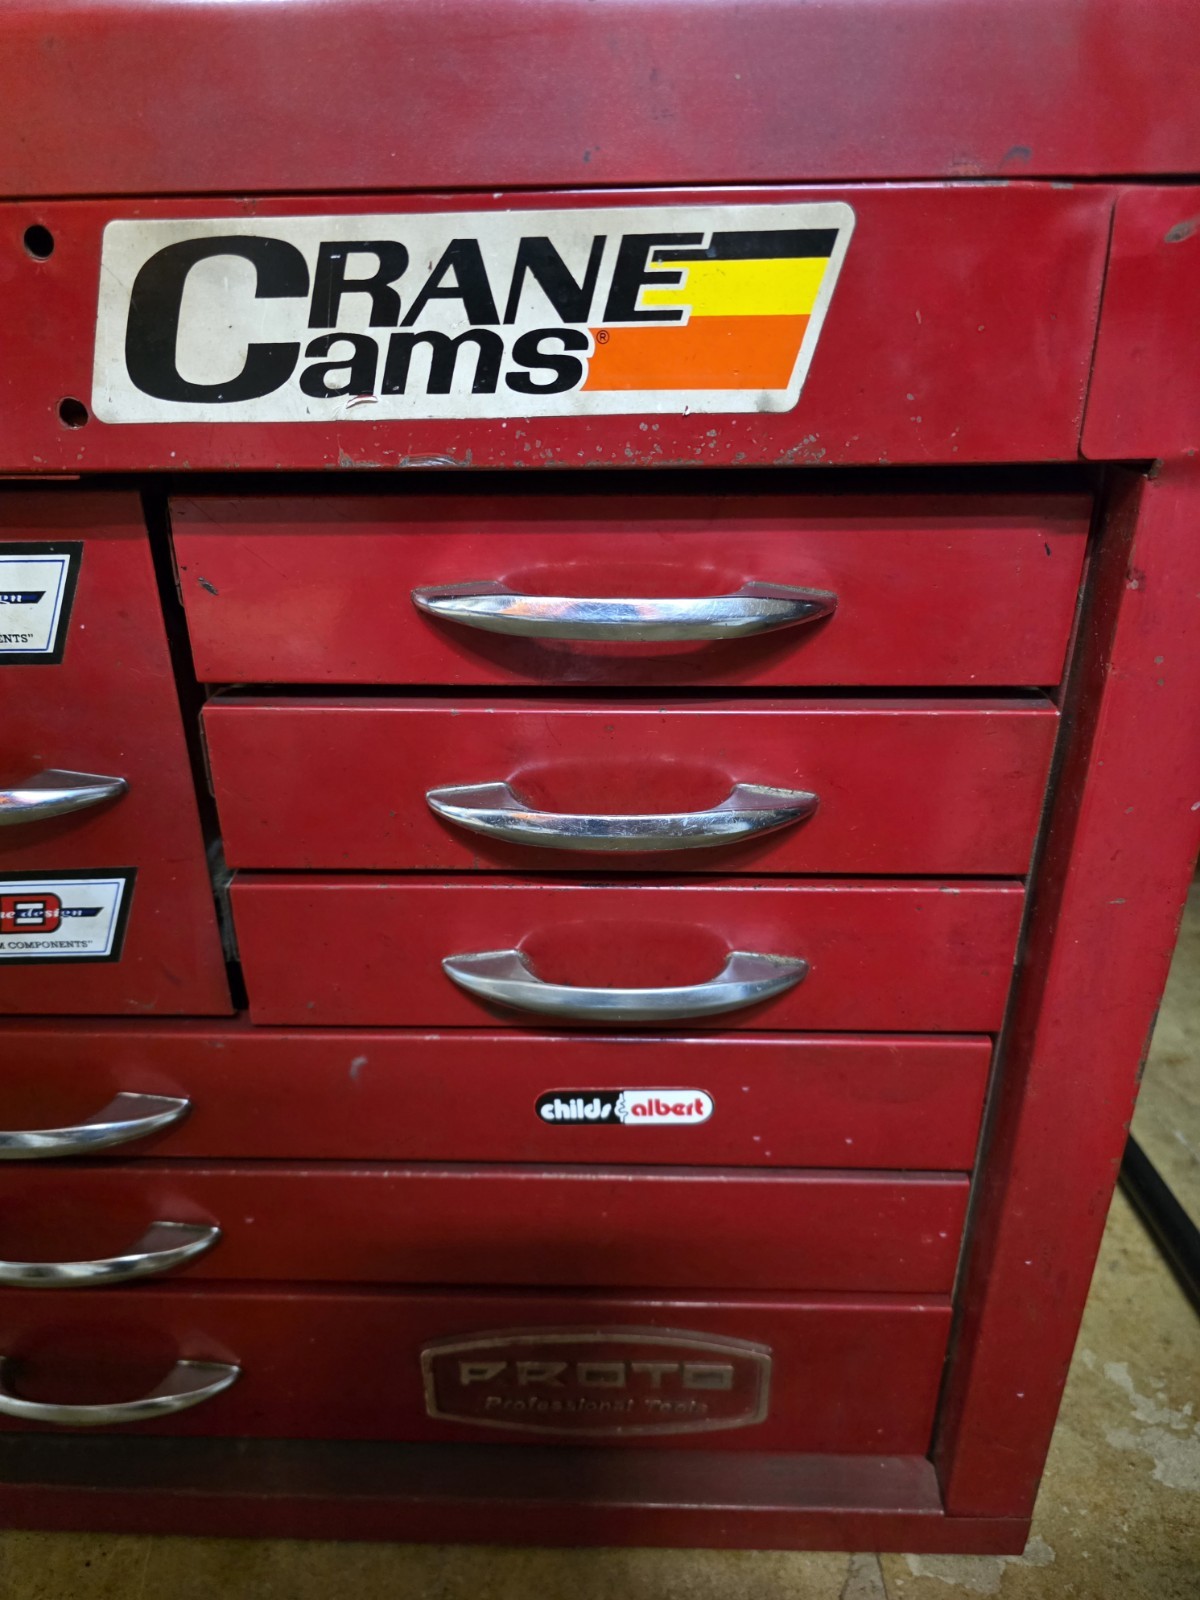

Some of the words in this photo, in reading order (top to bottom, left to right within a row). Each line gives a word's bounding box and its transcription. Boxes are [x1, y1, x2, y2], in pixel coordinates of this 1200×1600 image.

[540, 1098, 612, 1120] childs
[631, 1098, 704, 1117] albert
[459, 1361, 734, 1390] PROTO
[484, 1396, 635, 1413] Professional
[645, 1398, 708, 1415] Tools
